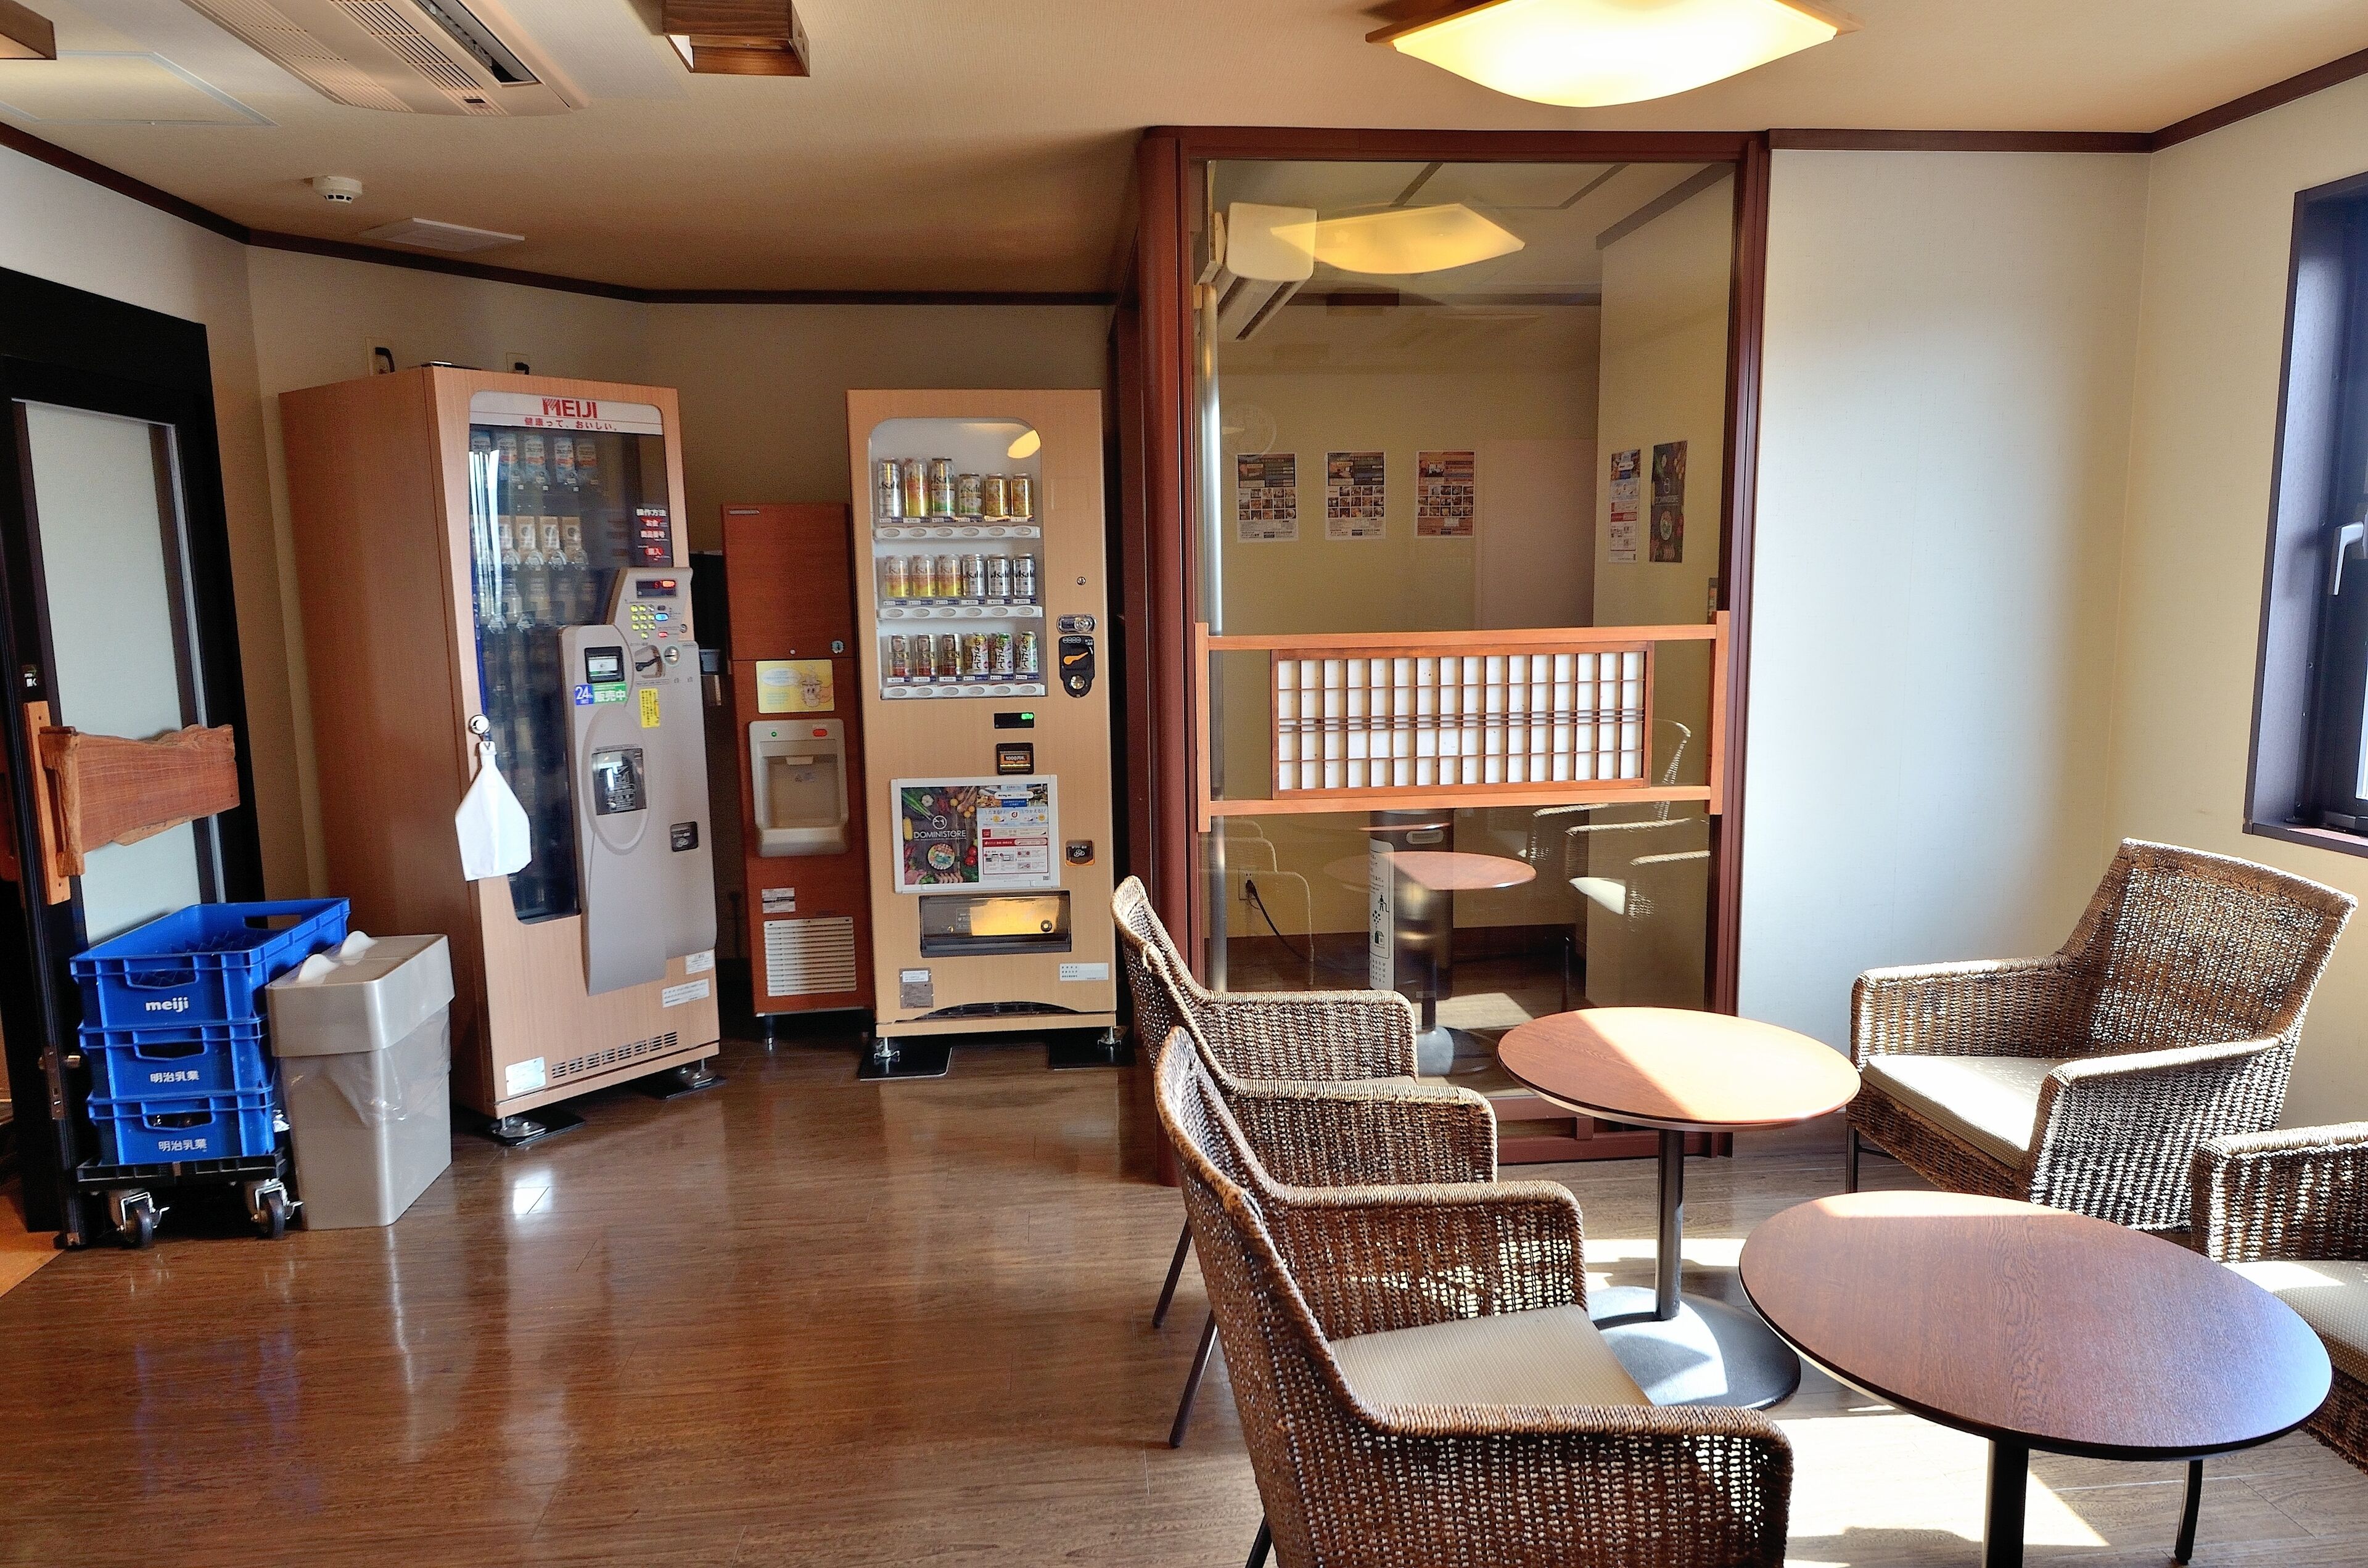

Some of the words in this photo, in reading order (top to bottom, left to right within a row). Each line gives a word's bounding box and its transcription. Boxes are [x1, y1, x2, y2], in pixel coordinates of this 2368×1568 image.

[542, 398, 598, 418] MEIJI
[997, 636, 1005, 668] もきたて
[913, 830, 966, 839] DOMINISTORE
[146, 997, 189, 1012] meiji
[150, 1070, 199, 1083] 明治乳業
[158, 1139, 207, 1151] 明治乳業
